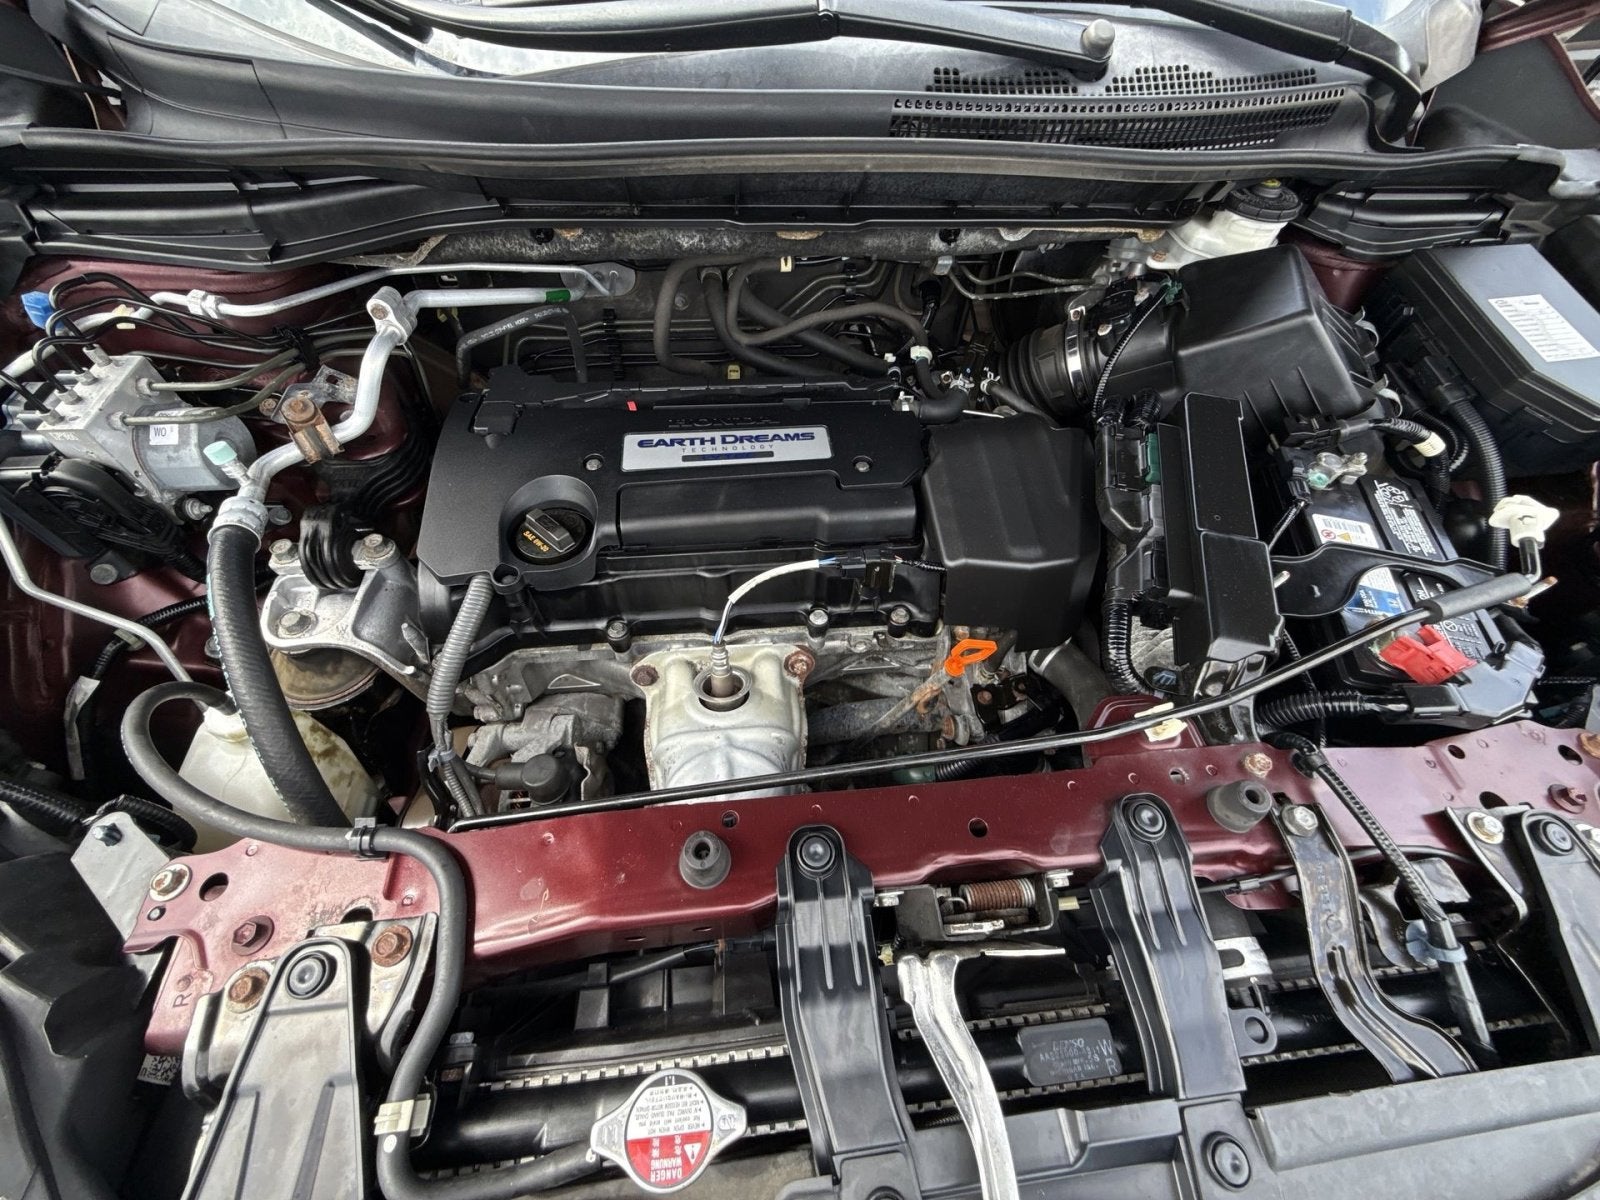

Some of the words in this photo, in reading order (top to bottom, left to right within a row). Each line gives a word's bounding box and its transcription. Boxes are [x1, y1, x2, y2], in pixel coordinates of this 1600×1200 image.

[637, 437, 716, 448] EARTH
[720, 432, 816, 444] DREAMS
[682, 444, 774, 453] TECHNOLOGY
[523, 530, 536, 541] SAE
[1098, 1040, 1113, 1056] W
[1105, 1058, 1118, 1075] R
[650, 1158, 683, 1169] WARNUNG
[650, 1169, 682, 1182] DANGER
